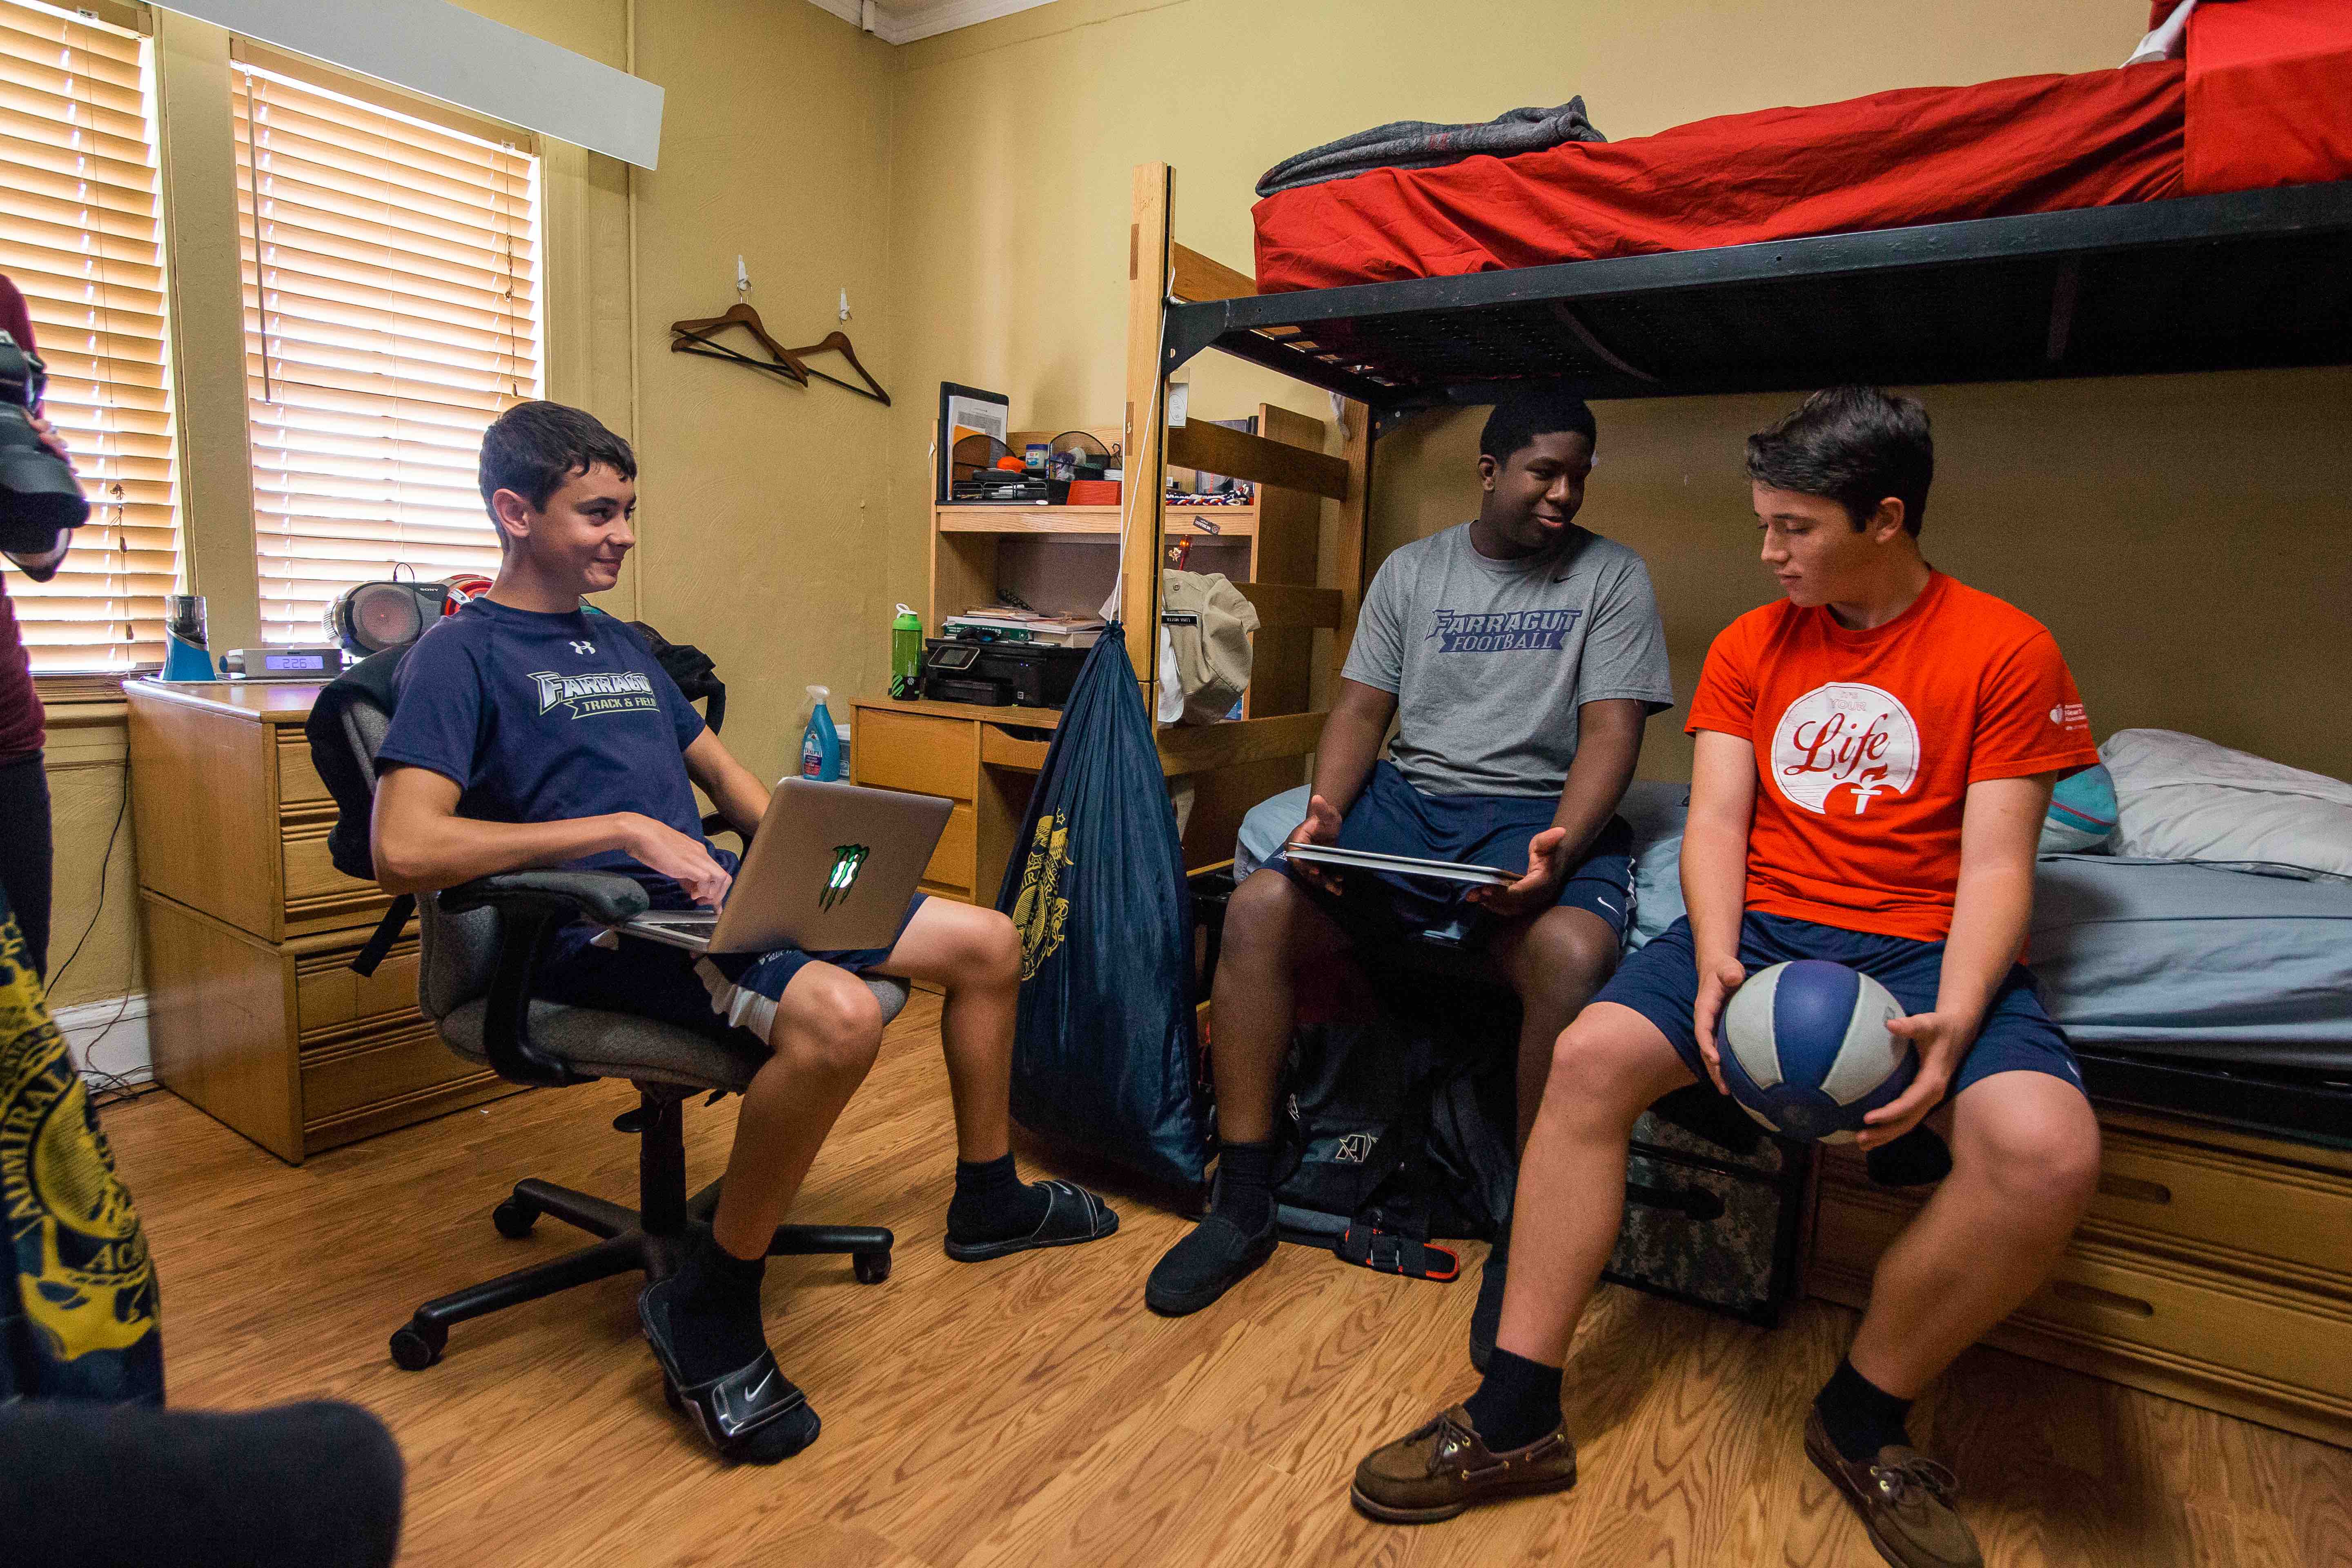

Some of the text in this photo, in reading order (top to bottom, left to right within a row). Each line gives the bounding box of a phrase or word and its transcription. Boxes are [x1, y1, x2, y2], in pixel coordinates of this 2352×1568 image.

[1425, 610, 1583, 641] FARRAGUT
[1452, 634, 1552, 651] FOOTBALL
[533, 673, 652, 709] FARRAGU
[582, 697, 657, 712] TRACK & FIELD
[1829, 698, 1866, 711] YOUR
[1784, 712, 1891, 780] Life
